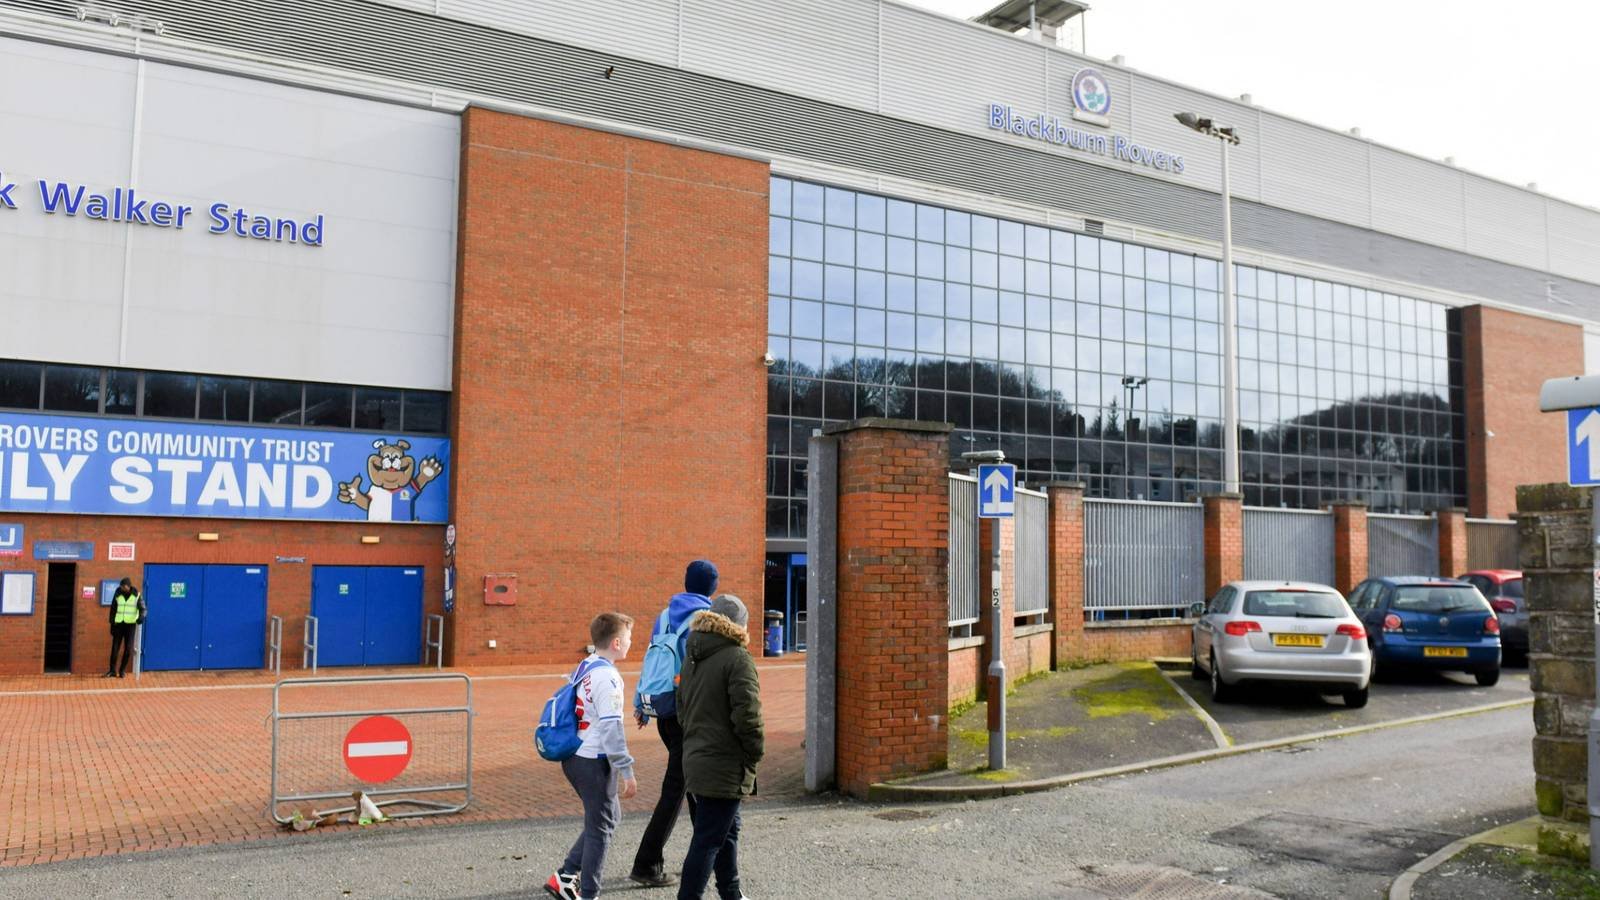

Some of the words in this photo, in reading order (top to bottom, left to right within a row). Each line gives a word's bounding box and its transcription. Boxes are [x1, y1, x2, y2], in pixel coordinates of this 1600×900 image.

[990, 103, 1106, 153] Blackburn
[1114, 134, 1185, 172] Rovers
[38, 179, 192, 229] Walker
[208, 202, 324, 246] Stand
[0, 424, 99, 452] ROVERS
[107, 430, 255, 460] COMMUNITY
[262, 438, 335, 464] TRUST
[0, 450, 90, 502] LY
[109, 456, 334, 509] STAND
